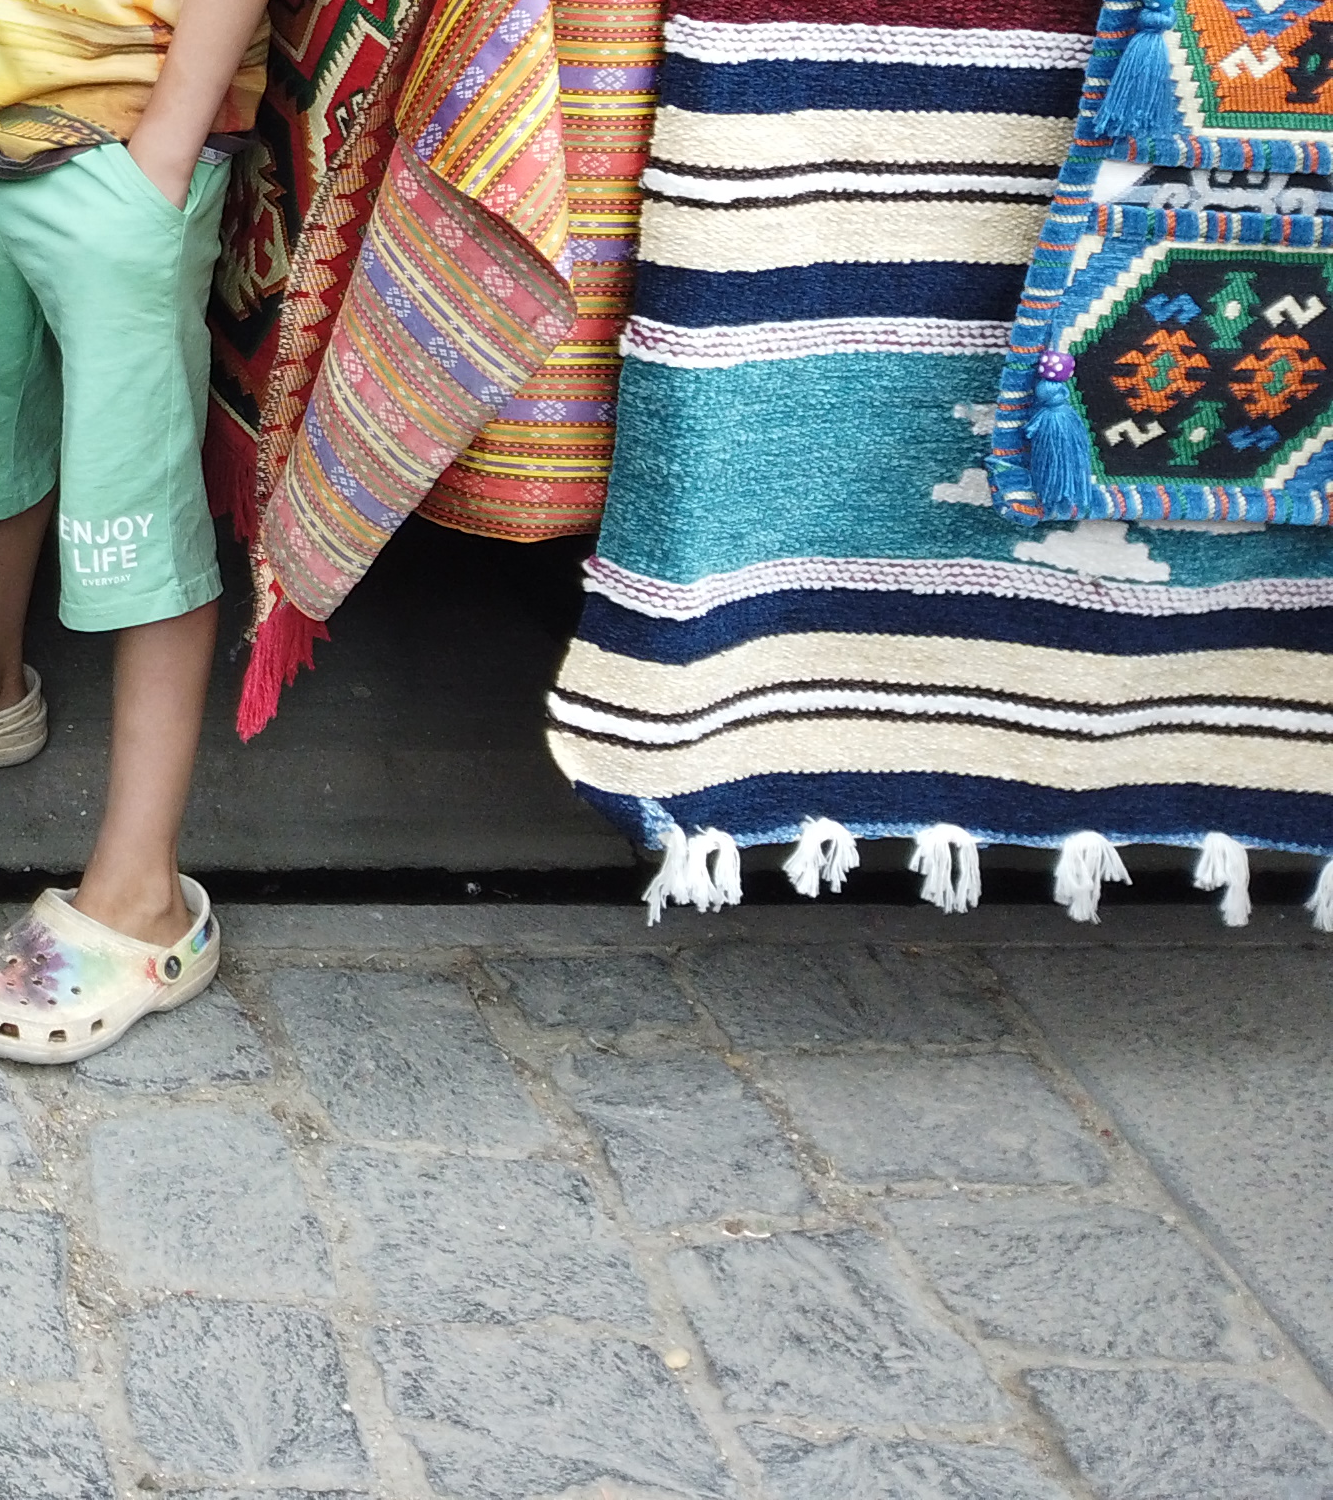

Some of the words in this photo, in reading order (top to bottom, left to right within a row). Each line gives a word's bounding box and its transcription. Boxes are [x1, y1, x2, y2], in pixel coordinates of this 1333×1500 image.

[59, 513, 154, 545] ENJOY
[73, 543, 139, 574] LIFE
[82, 573, 132, 587] EVERYDAY
